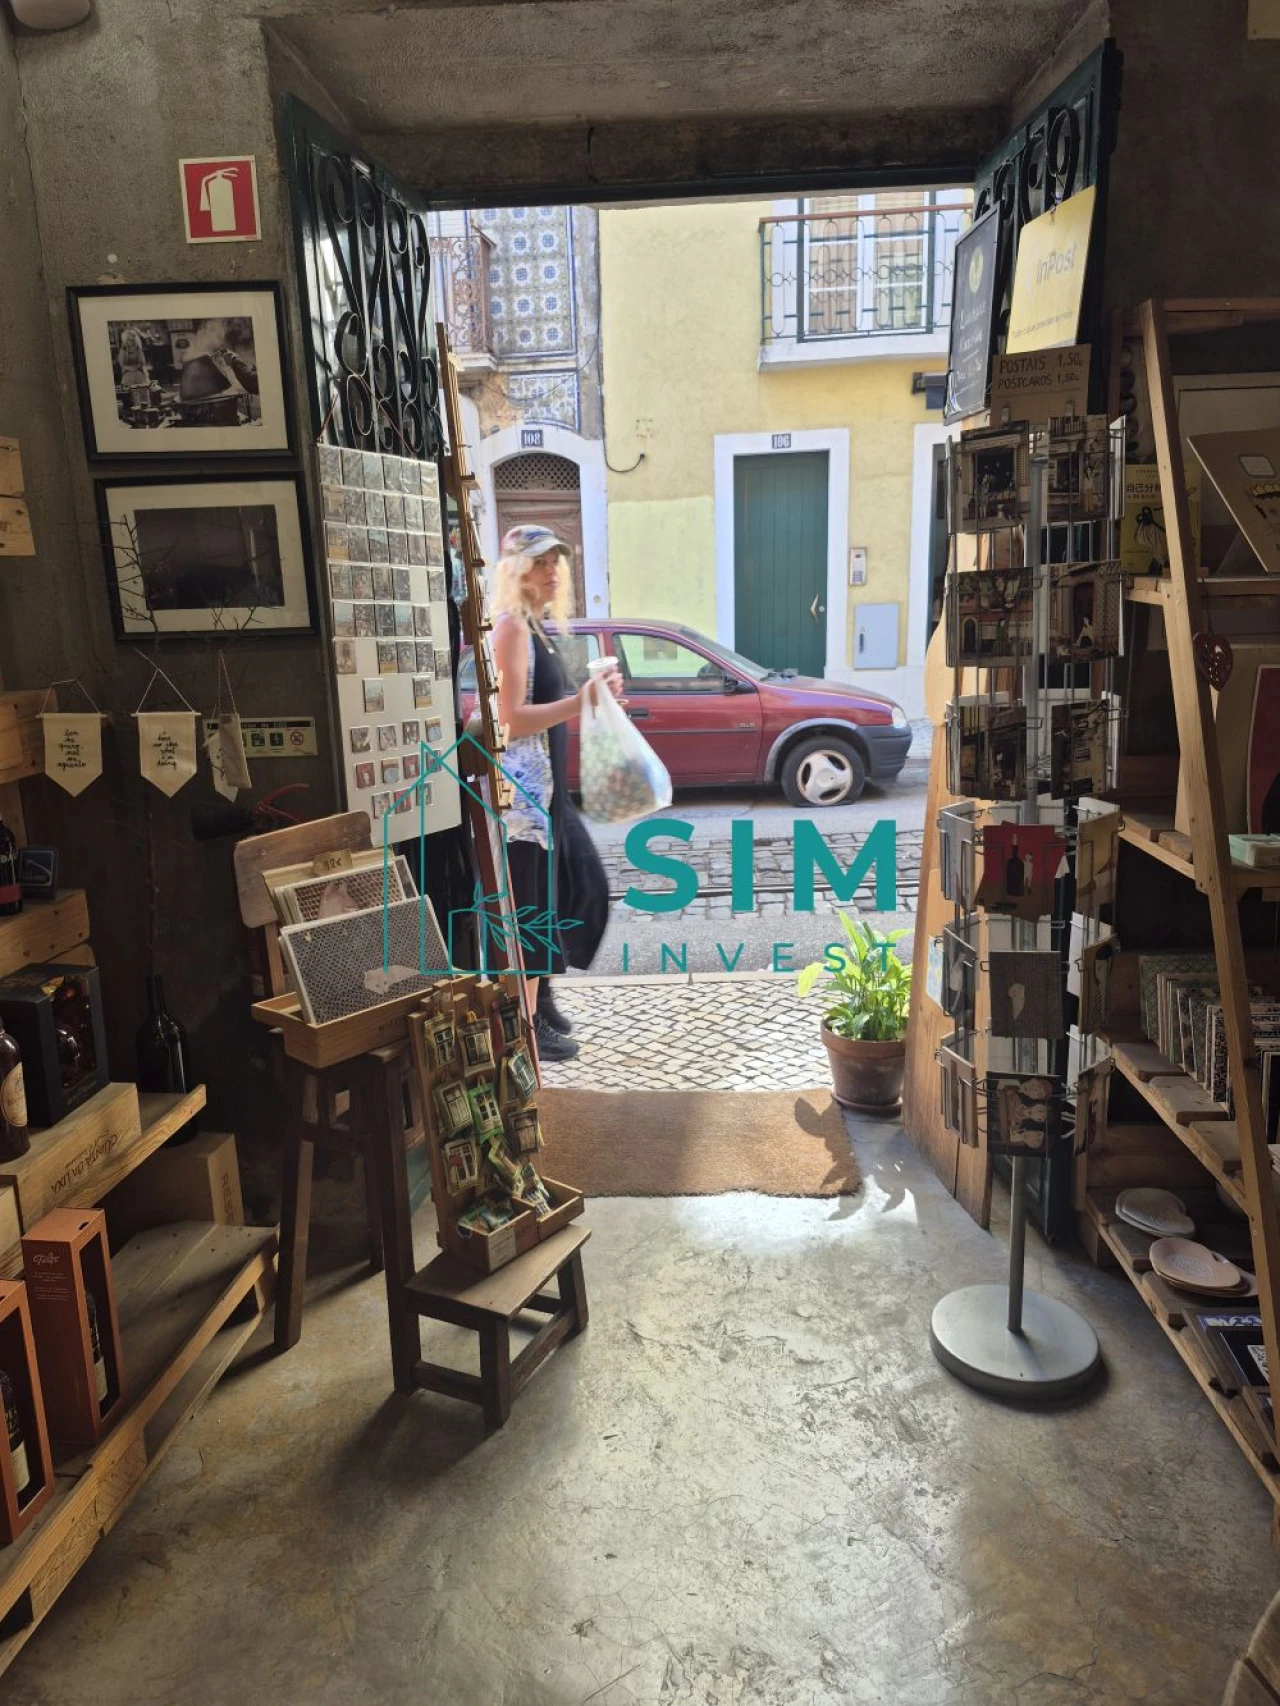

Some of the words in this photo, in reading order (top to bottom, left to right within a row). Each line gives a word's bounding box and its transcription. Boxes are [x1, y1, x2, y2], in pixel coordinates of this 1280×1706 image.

[999, 356, 1046, 375] POSTAIS
[997, 374, 1053, 390] POSTCARDS
[524, 432, 541, 445] 108
[774, 434, 789, 448] 106
